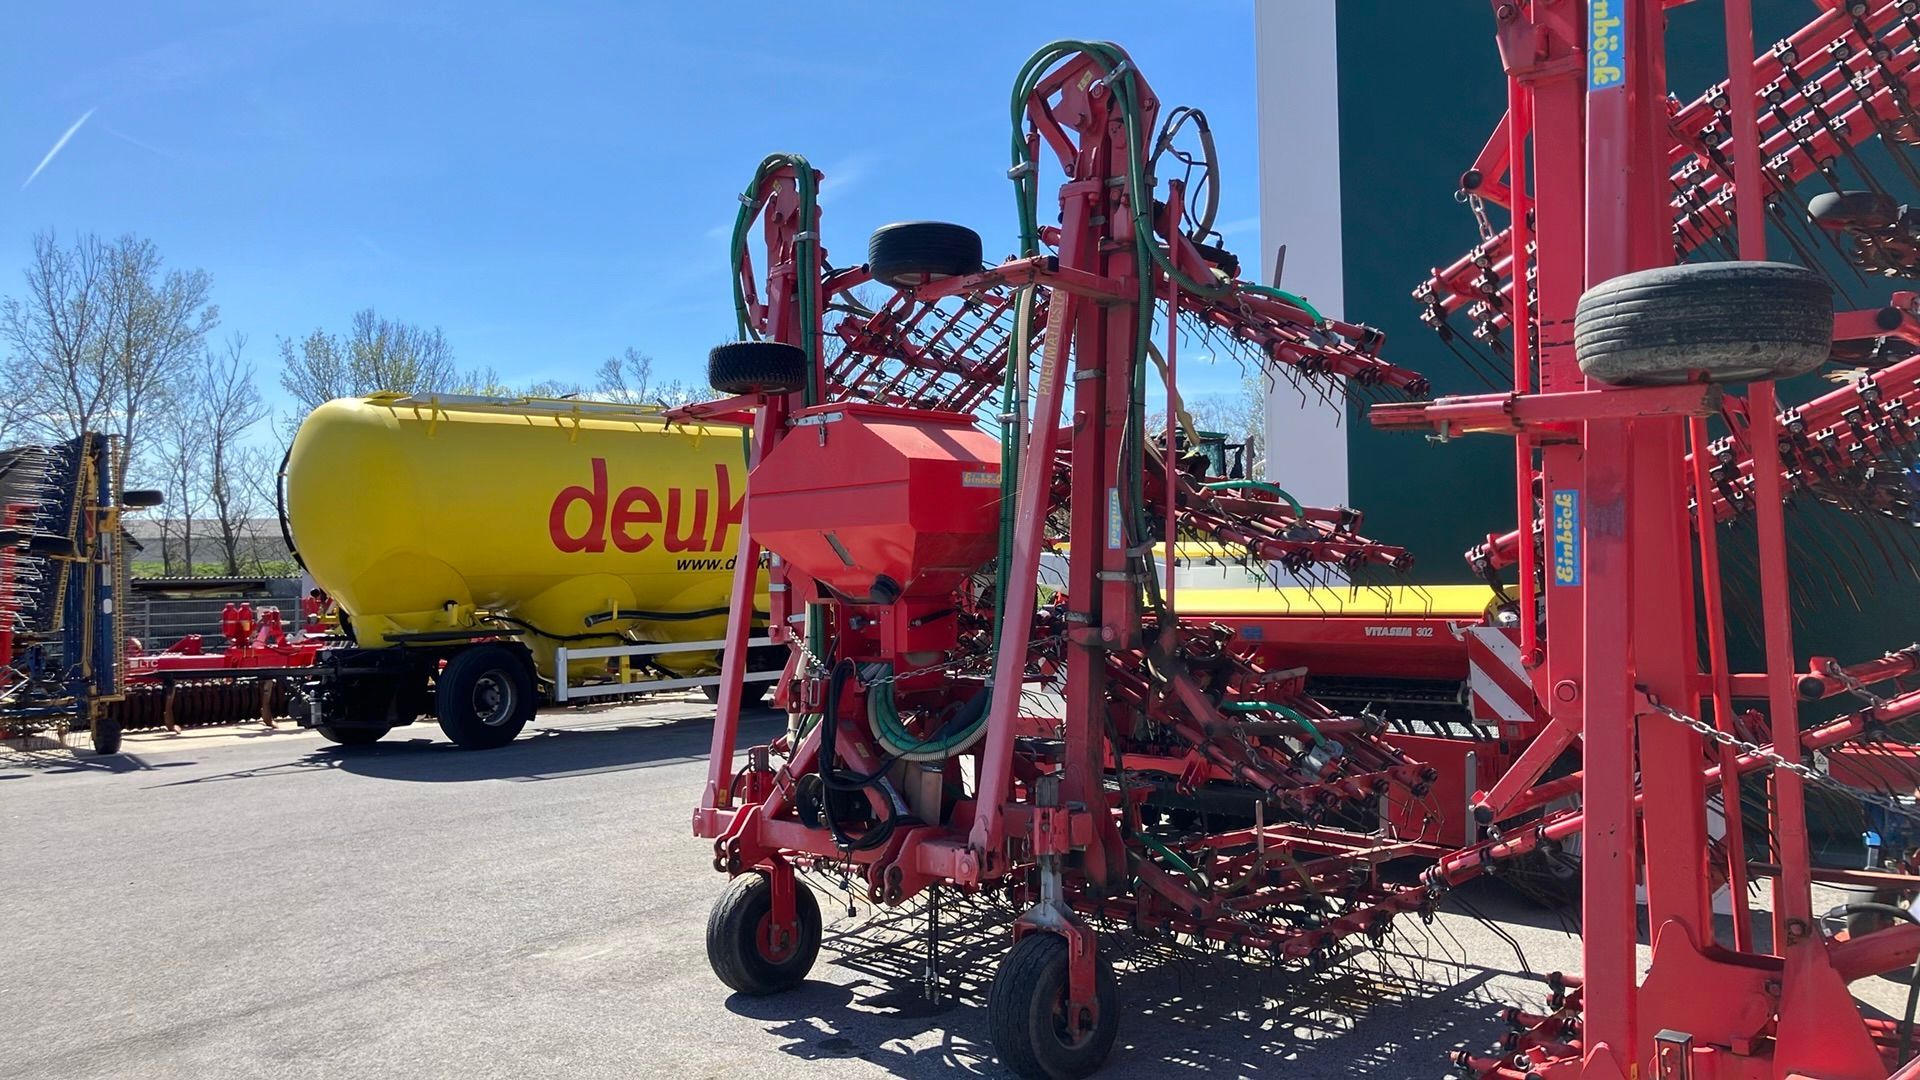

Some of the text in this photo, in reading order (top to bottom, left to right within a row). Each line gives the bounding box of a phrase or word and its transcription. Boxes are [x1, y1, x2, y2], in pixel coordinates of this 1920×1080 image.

[1555, 493, 1573, 582] Einböck
[1364, 626, 1433, 637] VITASEM 302
